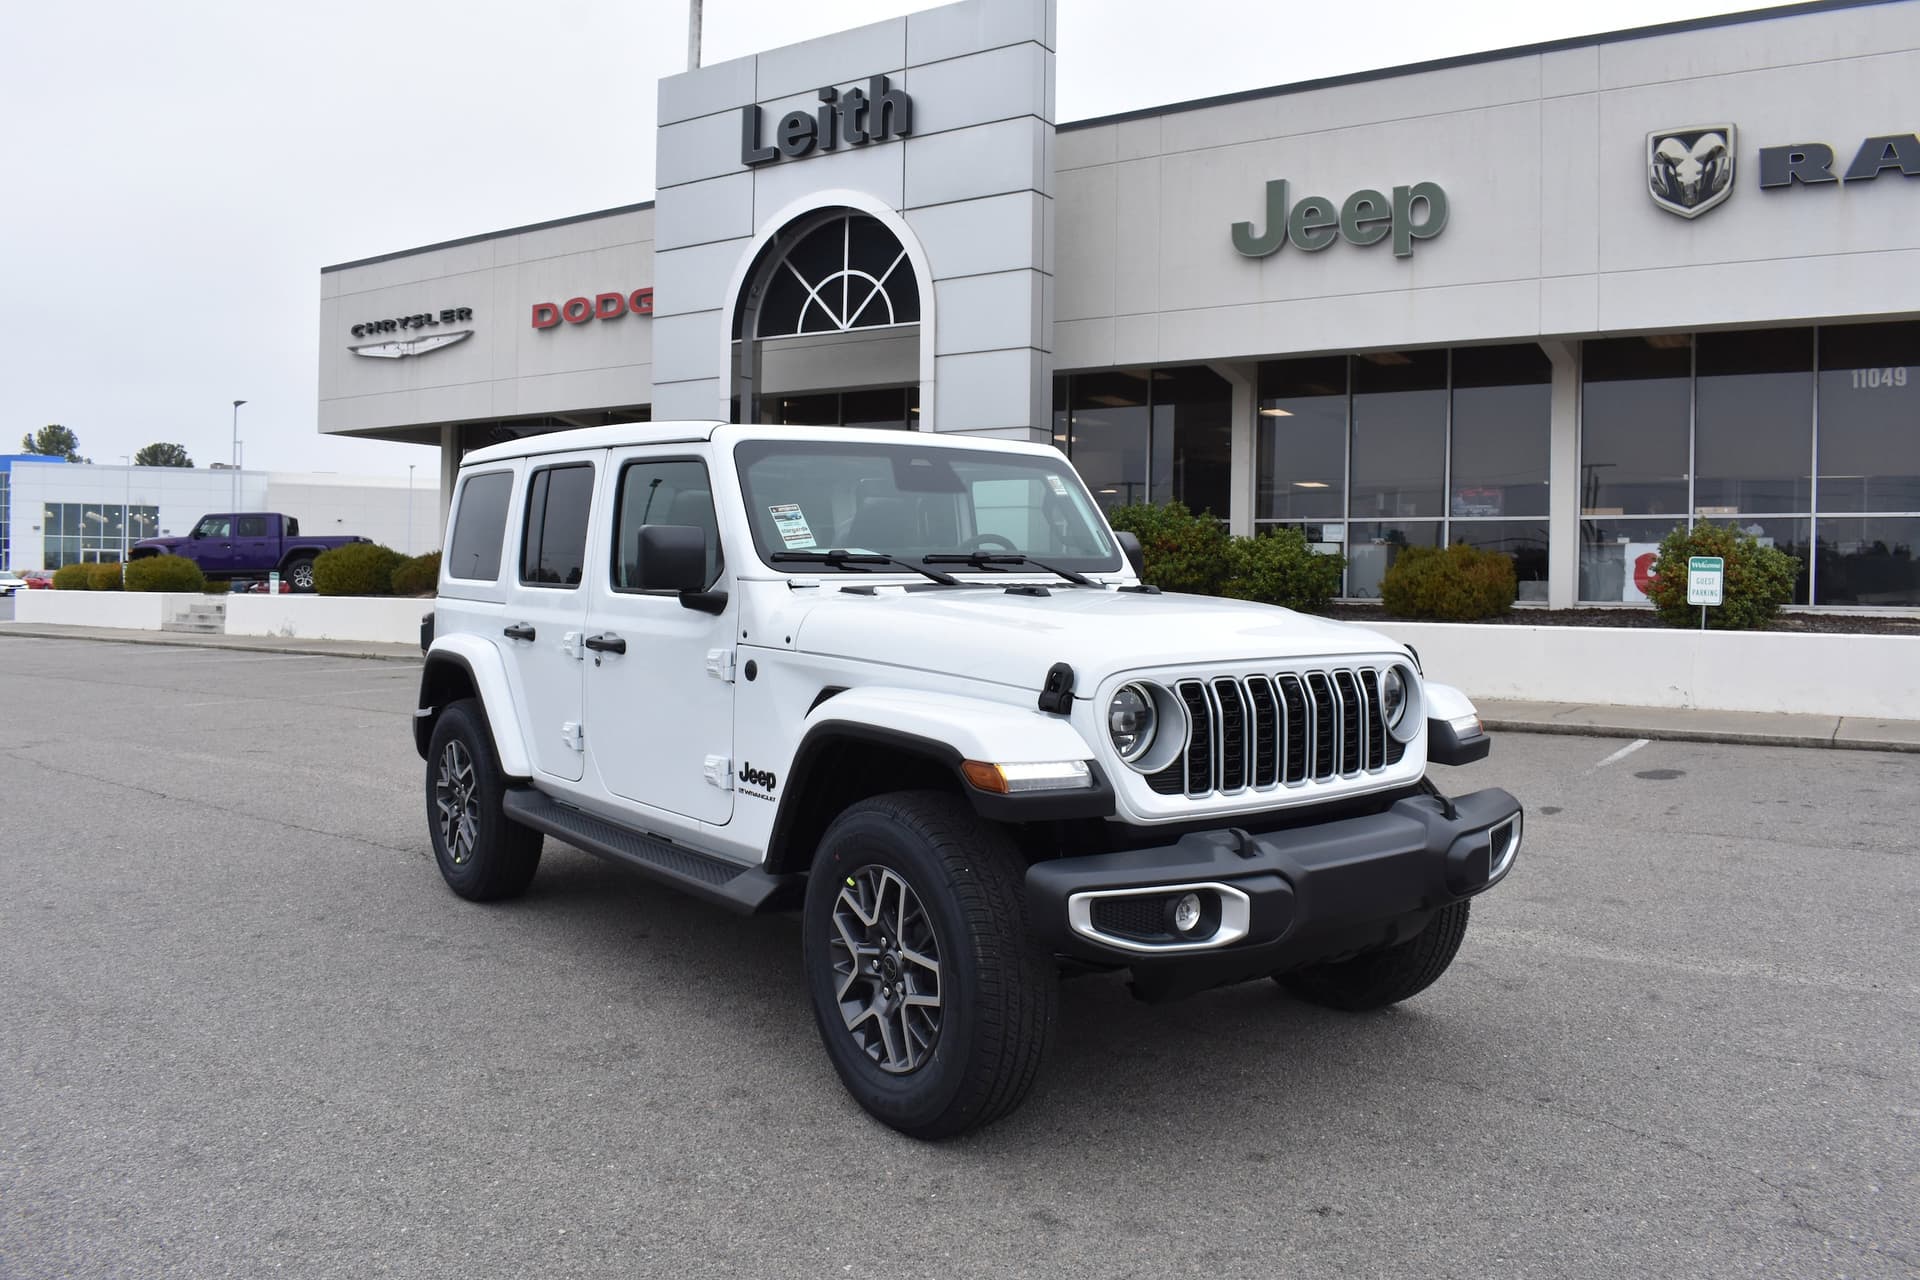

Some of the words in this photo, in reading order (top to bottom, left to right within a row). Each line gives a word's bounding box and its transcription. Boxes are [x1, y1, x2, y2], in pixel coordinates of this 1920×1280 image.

[742, 74, 912, 165] Leith
[1759, 133, 1920, 189] RA
[1231, 179, 1449, 258] Jeep
[351, 306, 473, 337] CHRYSLER
[531, 287, 654, 331] DODG
[1851, 366, 1907, 389] 11049
[1691, 560, 1721, 569] Welcome
[1691, 588, 1719, 597] PARKING
[1695, 577, 1715, 585] GUEST
[739, 761, 777, 793] Jeep
